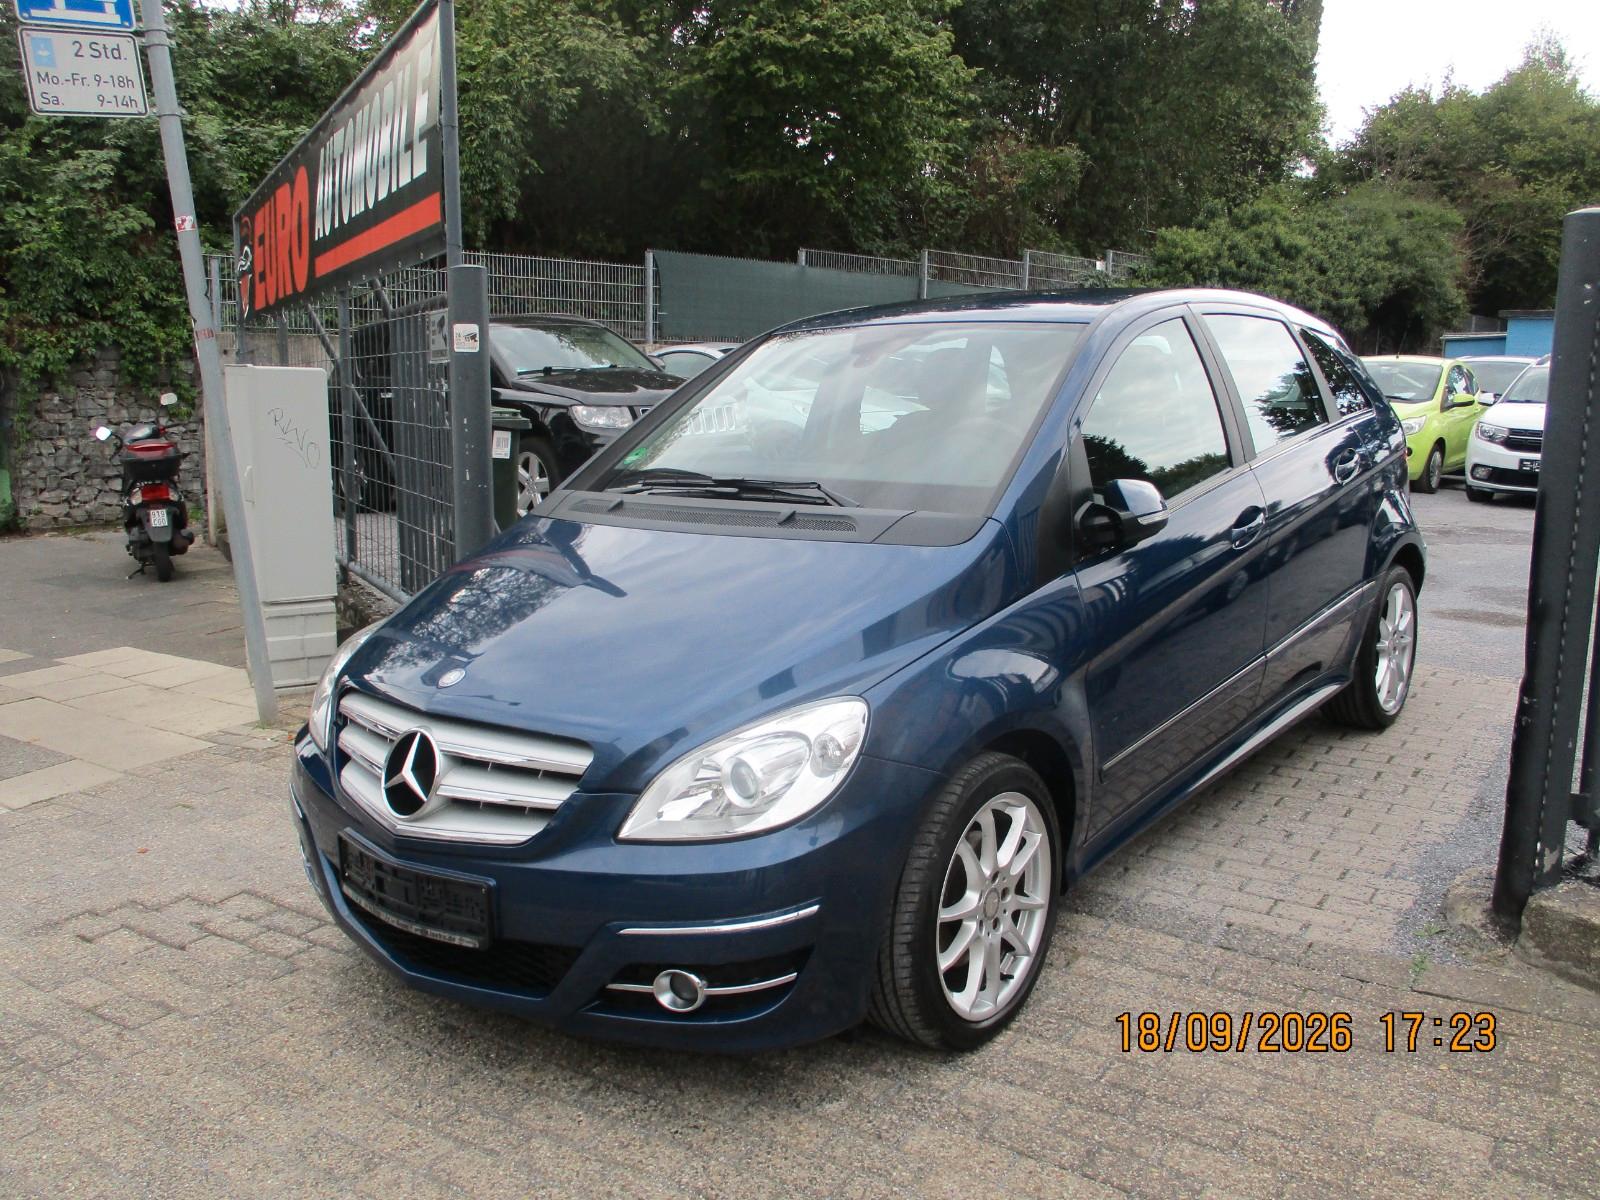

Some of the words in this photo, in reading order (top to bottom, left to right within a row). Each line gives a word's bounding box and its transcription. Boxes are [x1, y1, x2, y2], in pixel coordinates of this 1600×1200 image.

[72, 40, 84, 58] 2
[88, 41, 128, 61] Std.
[36, 71, 90, 88] Mo.-Fr.
[94, 73, 136, 89] 9-18h
[40, 91, 65, 106] Sa.
[97, 94, 139, 109] 9-14h
[254, 165, 310, 311] EURO
[314, 38, 433, 242] AUTOMOBILE
